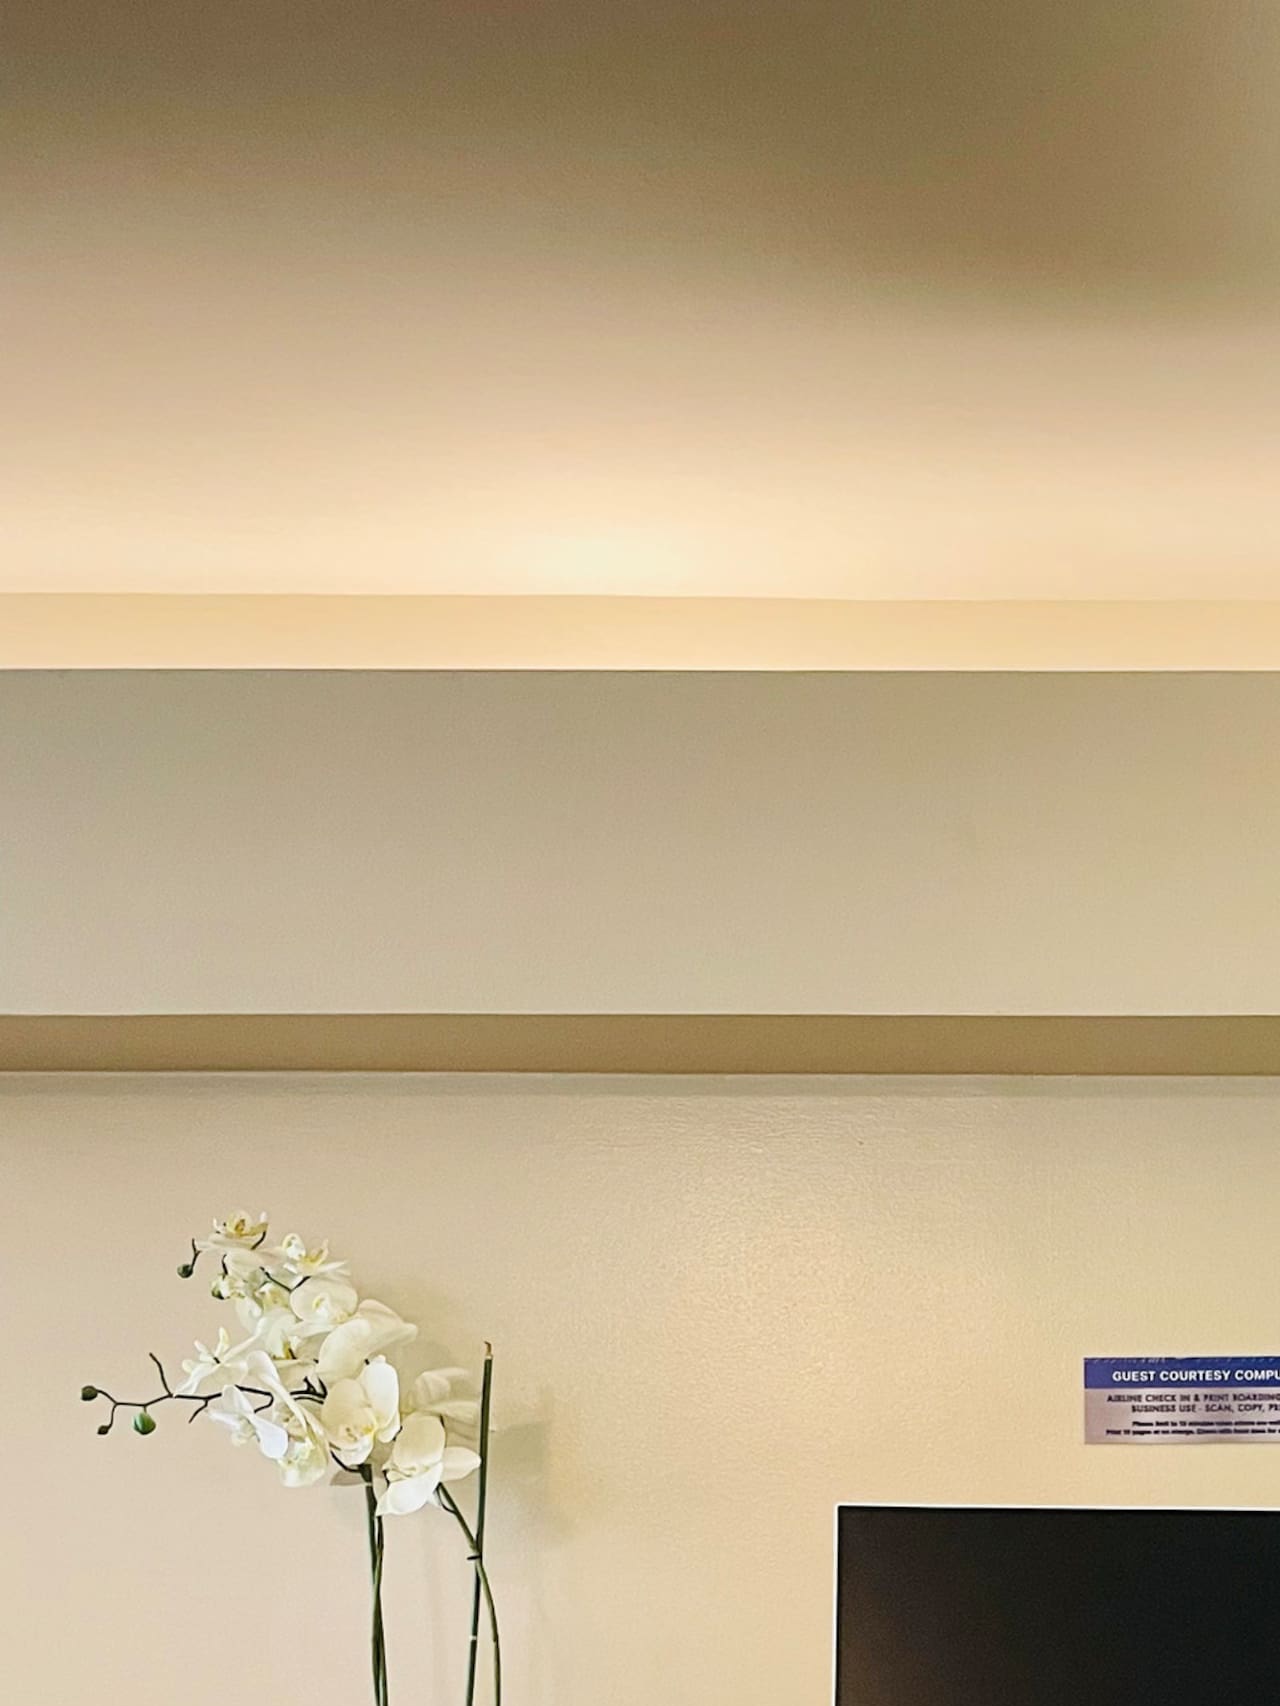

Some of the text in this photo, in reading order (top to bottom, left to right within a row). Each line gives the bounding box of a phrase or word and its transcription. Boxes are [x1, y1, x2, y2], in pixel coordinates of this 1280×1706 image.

[1112, 1371, 1155, 1381] GUEST
[1160, 1370, 1230, 1381] COURTESY
[1107, 1394, 1142, 1402] AIRLINE
[1145, 1394, 1177, 1402] CHECK
[1179, 1394, 1190, 1402] IN
[1193, 1394, 1200, 1402] &
[1203, 1394, 1229, 1402] PRINT
[1131, 1404, 1176, 1413] BUSINESS
[1179, 1404, 1196, 1413] USE
[1205, 1404, 1234, 1413] SCAN,
[1237, 1404, 1265, 1413] COPY,
